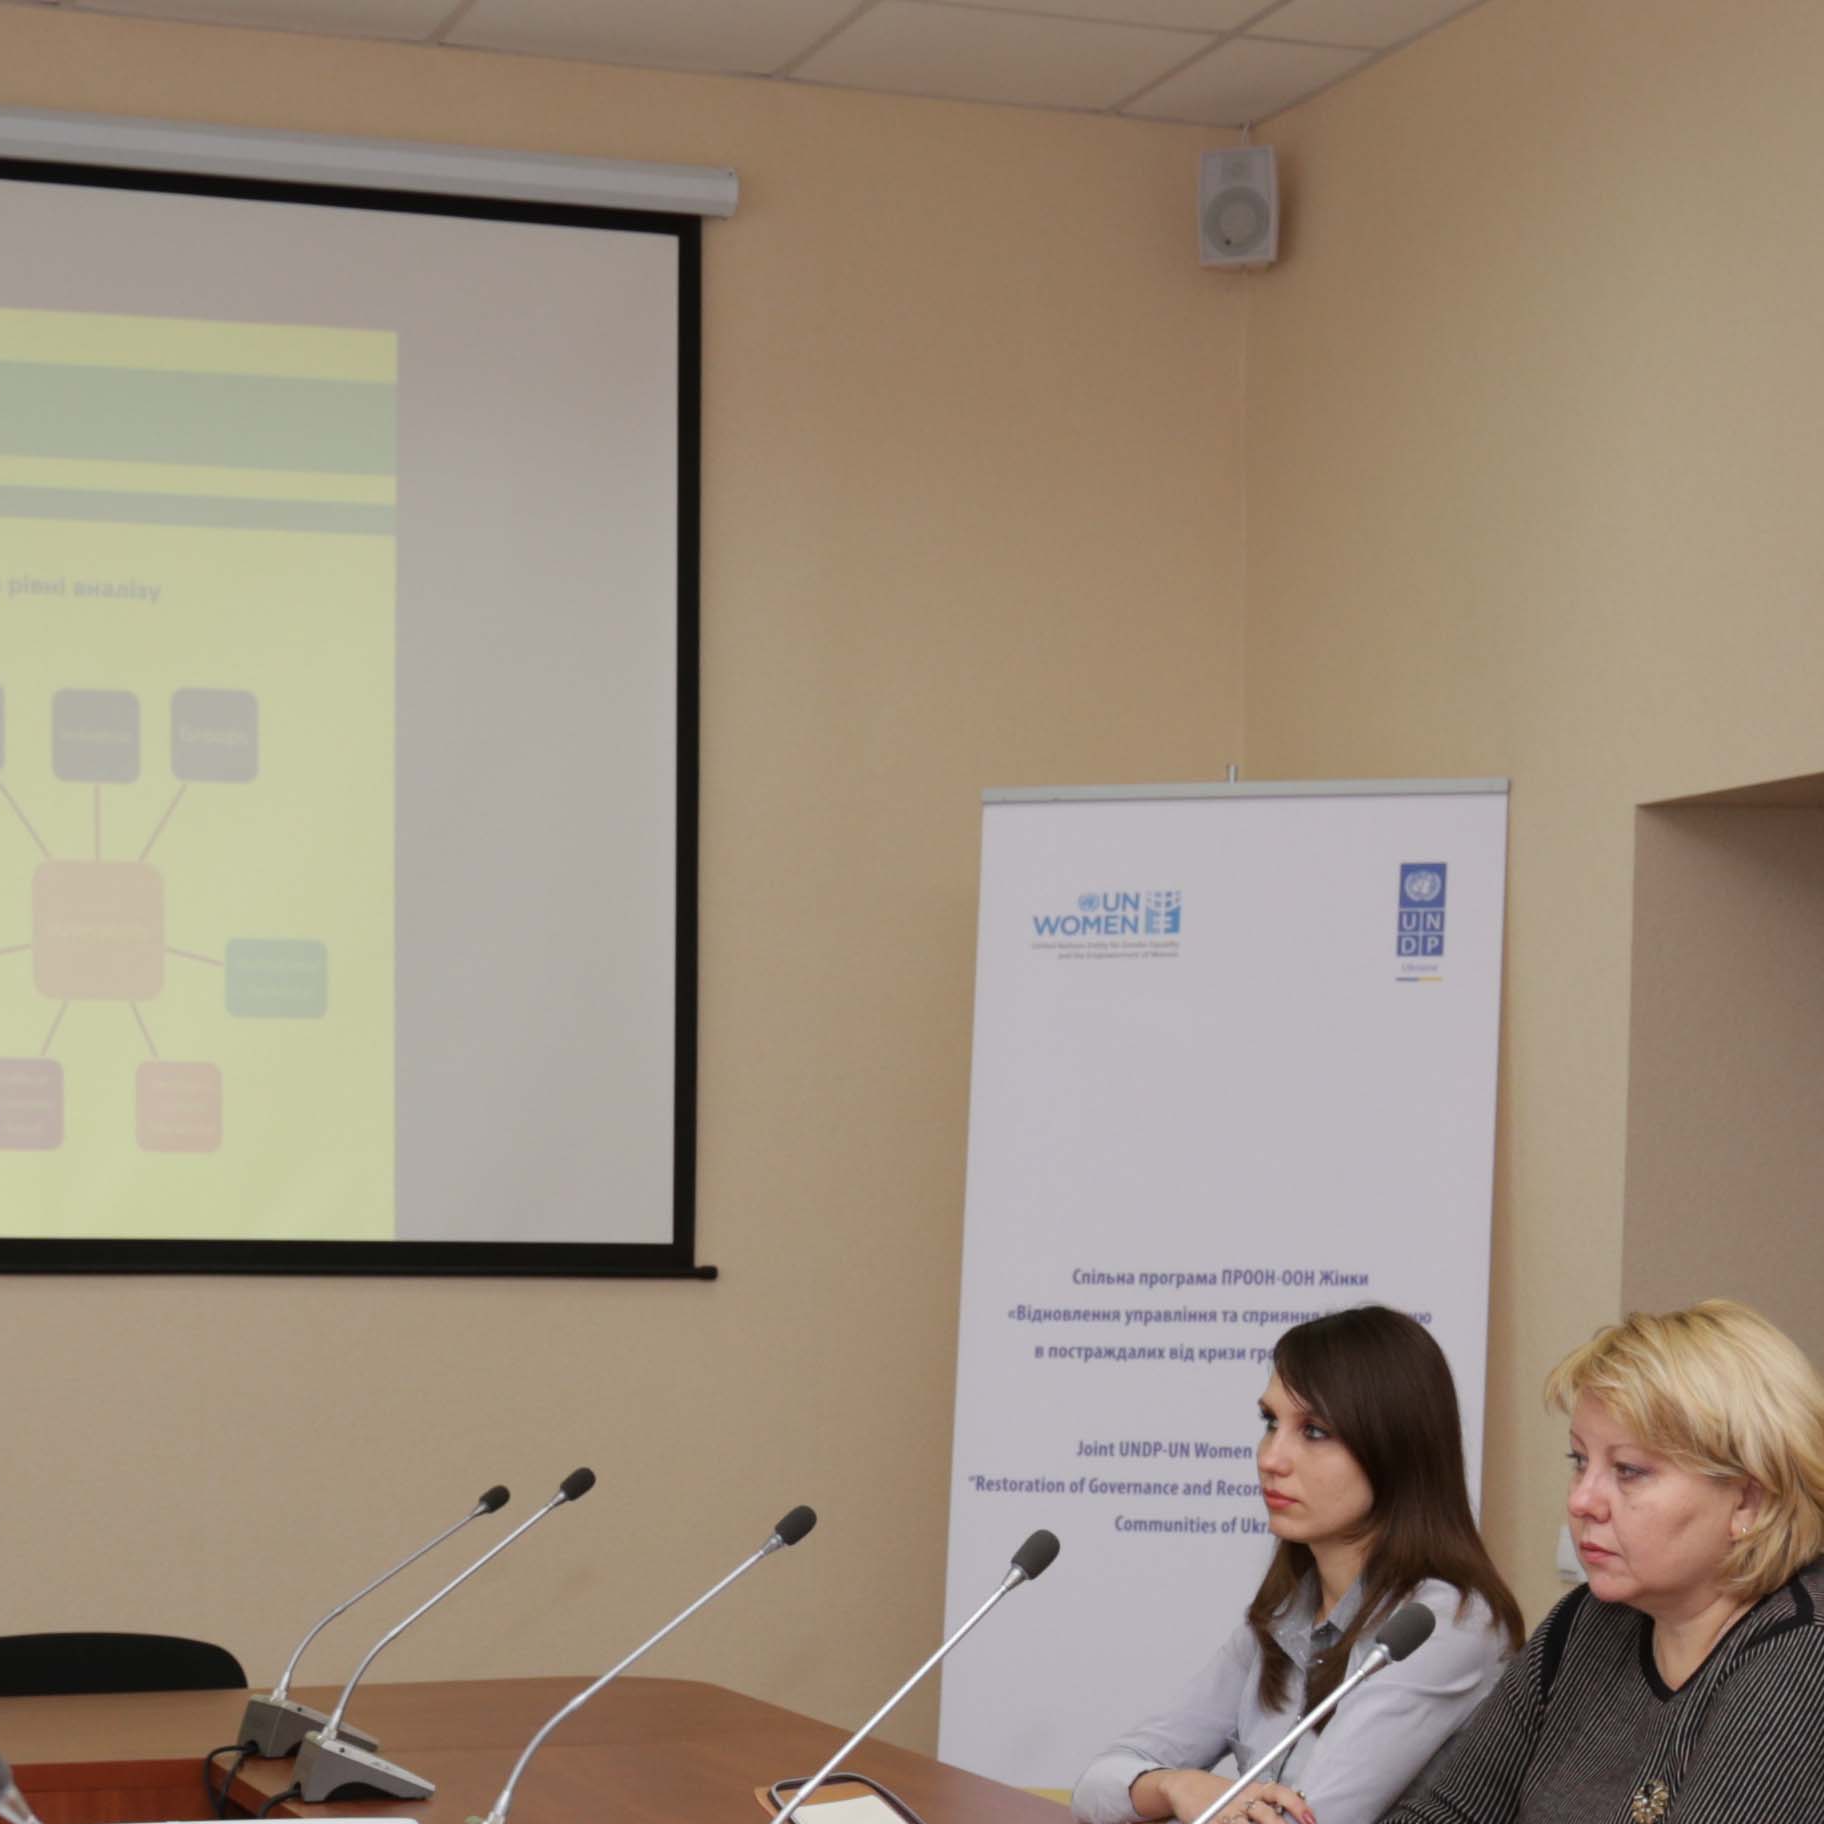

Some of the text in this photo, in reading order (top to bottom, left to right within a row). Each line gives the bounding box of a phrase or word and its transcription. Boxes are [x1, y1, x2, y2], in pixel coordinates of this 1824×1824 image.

[1103, 892, 1140, 912] UN
[1033, 914, 1139, 936] WOMEN
[1072, 1268, 1369, 1290] Спільна програма ПРООН-ООН Жінки
[1007, 1305, 1121, 1324] «Відновлення
[1124, 1306, 1217, 1326] управління
[1222, 1310, 1239, 1324] та
[1035, 1347, 1044, 1359] в
[1047, 1344, 1165, 1363] постраждалих
[1169, 1344, 1194, 1362] від
[1199, 1347, 1246, 1363] кризи
[1076, 1441, 1252, 1459] Joint UNDP-UN Women
[1069, 1476, 1085, 1494] of
[1089, 1477, 1178, 1496] Governance
[1183, 1479, 1211, 1496] and
[1217, 1481, 1263, 1497] Recon
[1115, 1515, 1271, 1534] Communities of Ukr
